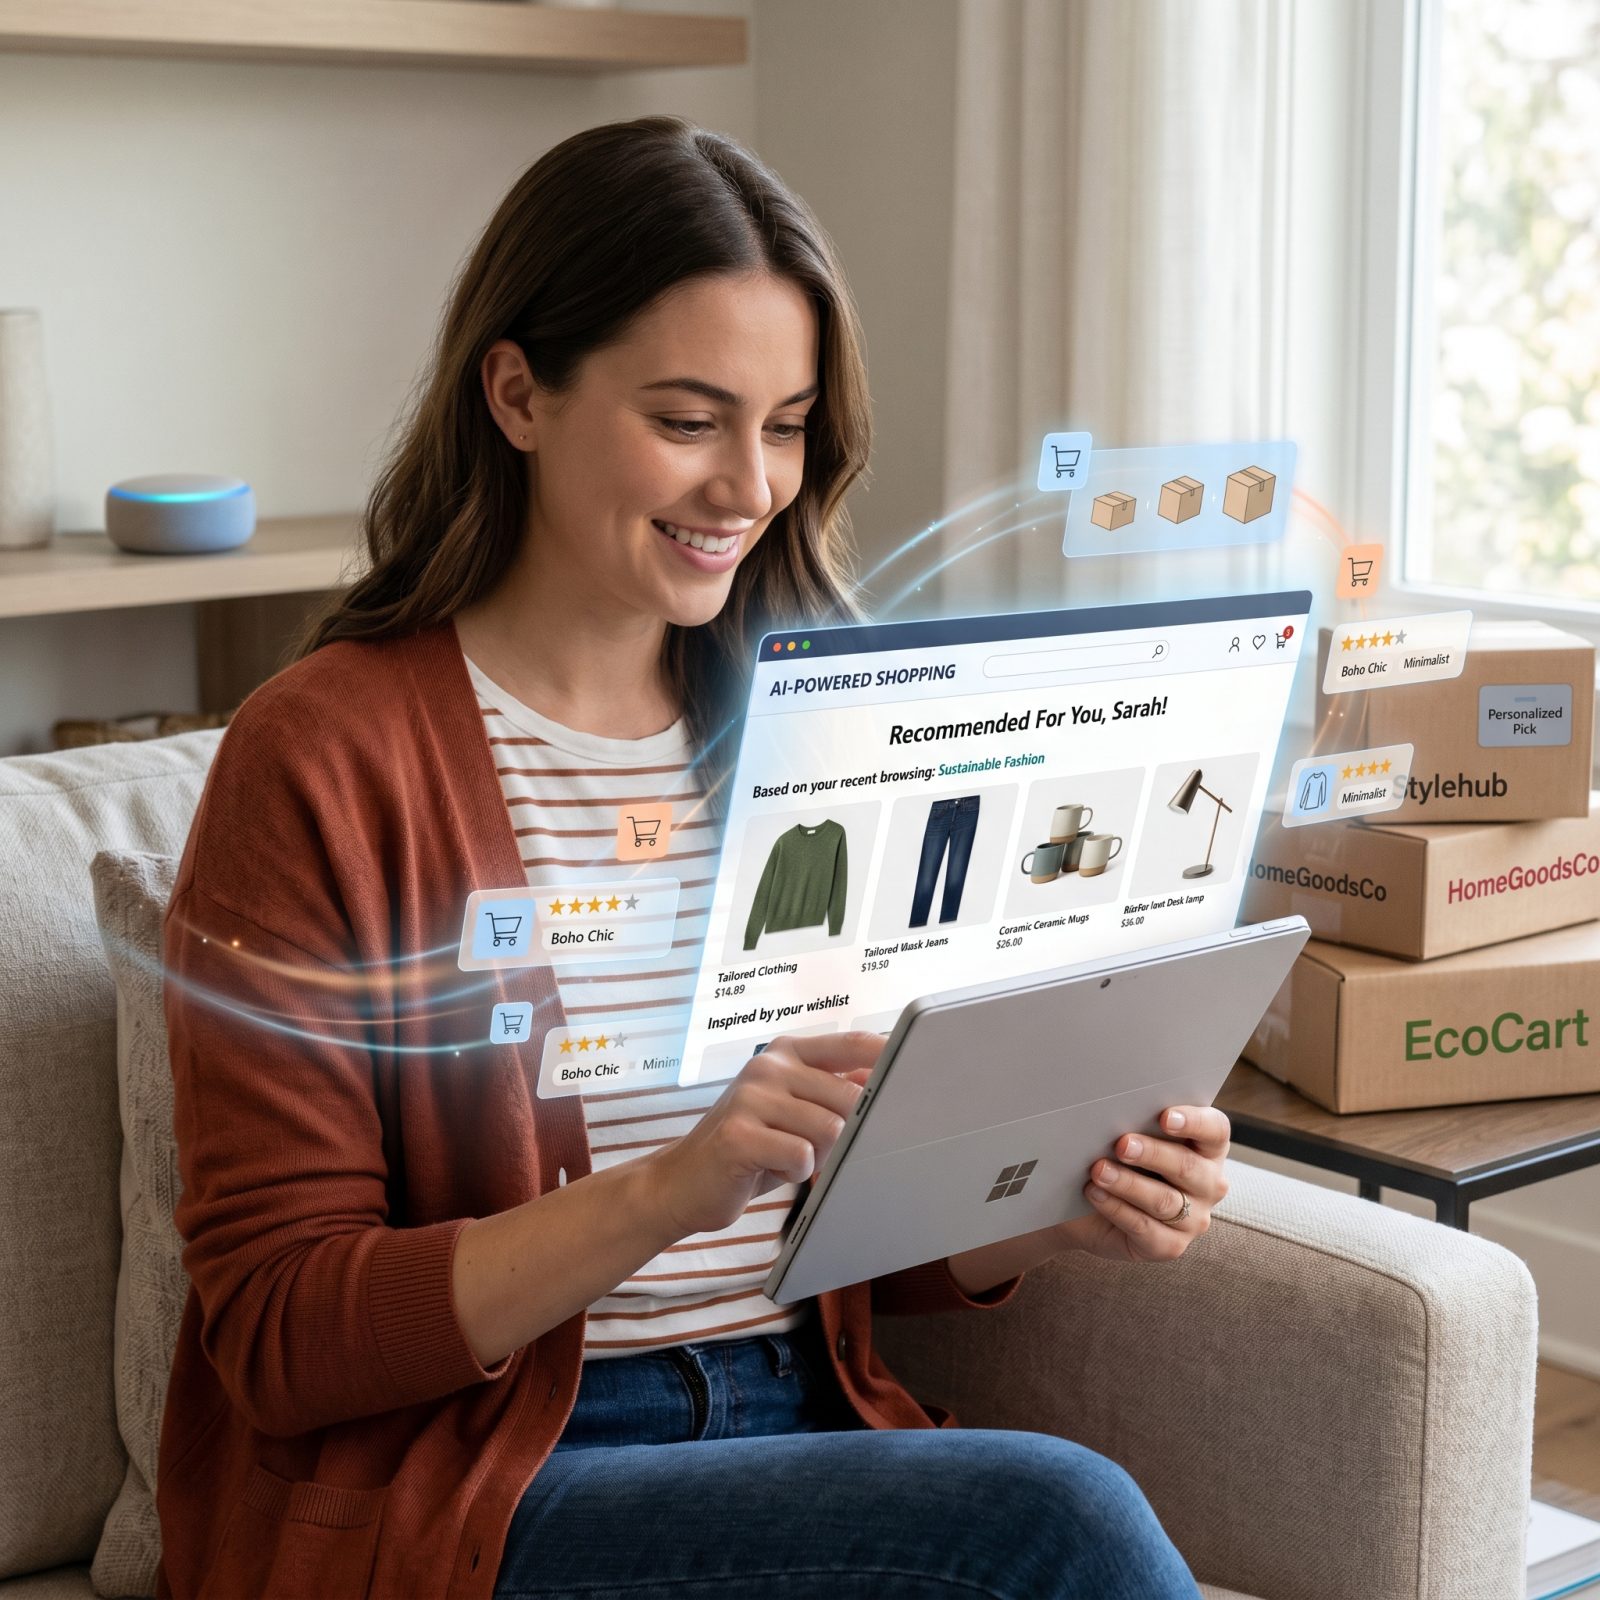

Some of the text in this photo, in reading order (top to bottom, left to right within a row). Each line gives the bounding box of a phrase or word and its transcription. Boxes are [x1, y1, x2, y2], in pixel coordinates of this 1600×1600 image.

[1341, 653, 1450, 678] Boho Chic Minimalist
[769, 664, 956, 696] AI-POWERED SHOPPING
[889, 696, 1168, 745] Recommended For You, Sarah!
[1488, 706, 1563, 721] Personalized
[1513, 722, 1537, 735] Pick
[753, 753, 1045, 799] Based on your recent browsing: Sustainable Fashion
[1342, 787, 1386, 804] Minimalist
[1392, 772, 1508, 805] Stylehub
[1448, 852, 1599, 905] HomeGoodsCo
[1167, 896, 1184, 907] Desk
[1033, 916, 1066, 931] Ceramic
[1067, 913, 1090, 926] Mugs
[1121, 916, 1145, 928] $36.00
[551, 928, 615, 945] Boho Chic
[996, 937, 1023, 950] $26.00
[864, 943, 899, 958] Tailored
[925, 937, 949, 948] Jeans
[718, 961, 798, 983] Tailored Clothing
[861, 959, 890, 973] $19.50
[714, 984, 745, 998] $14.89
[707, 994, 850, 1030] Inspired by your wishlist
[1405, 1009, 1590, 1061] EcoCart
[560, 1067, 591, 1081] Boho
[594, 1064, 620, 1077] Chic
